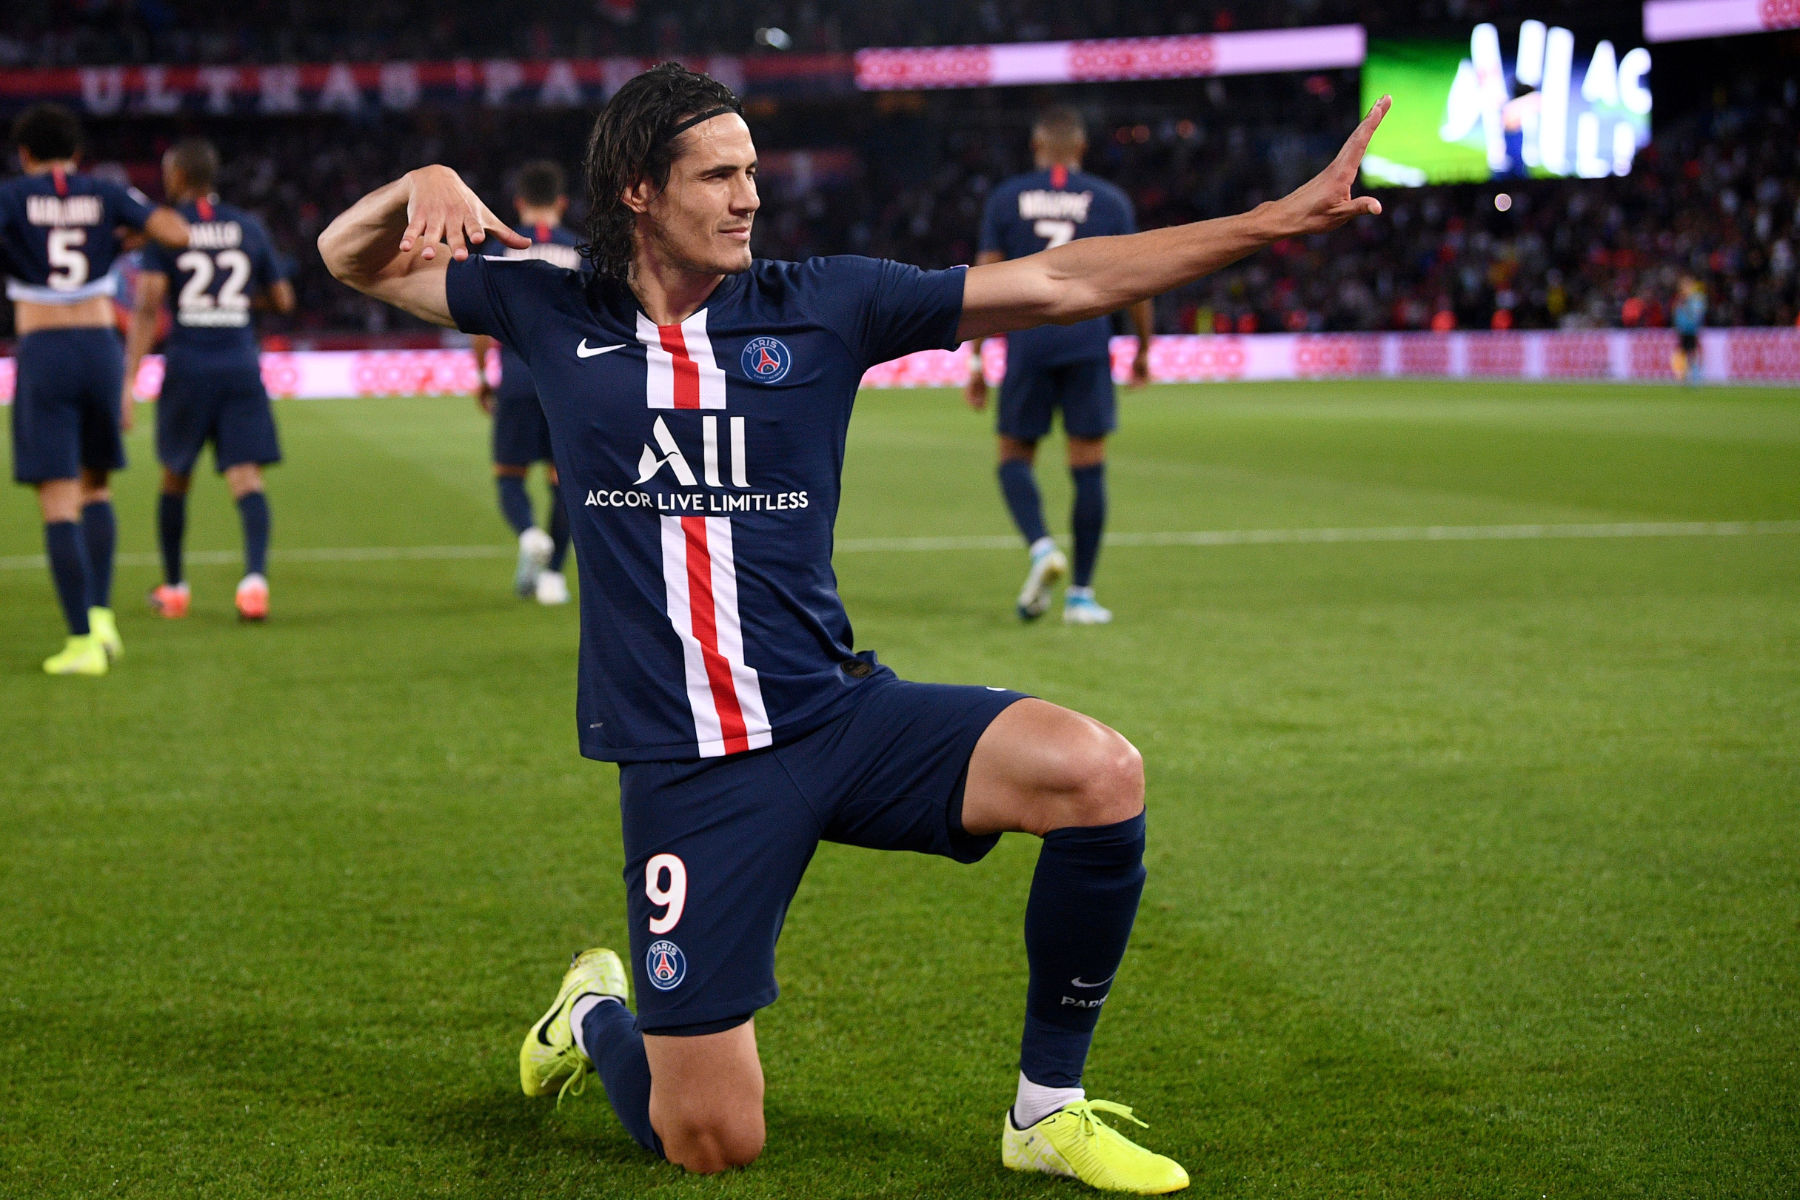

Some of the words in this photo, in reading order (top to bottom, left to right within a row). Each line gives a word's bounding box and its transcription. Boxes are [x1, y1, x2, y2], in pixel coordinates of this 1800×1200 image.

[48, 228, 88, 291] 5
[176, 249, 251, 308] 22
[746, 339, 778, 354] PARIS
[584, 489, 654, 508] ACCOR
[657, 492, 705, 511] LIVE
[710, 491, 809, 512] LIMITLESS
[645, 852, 688, 935] 9
[651, 942, 678, 956] PARIS
